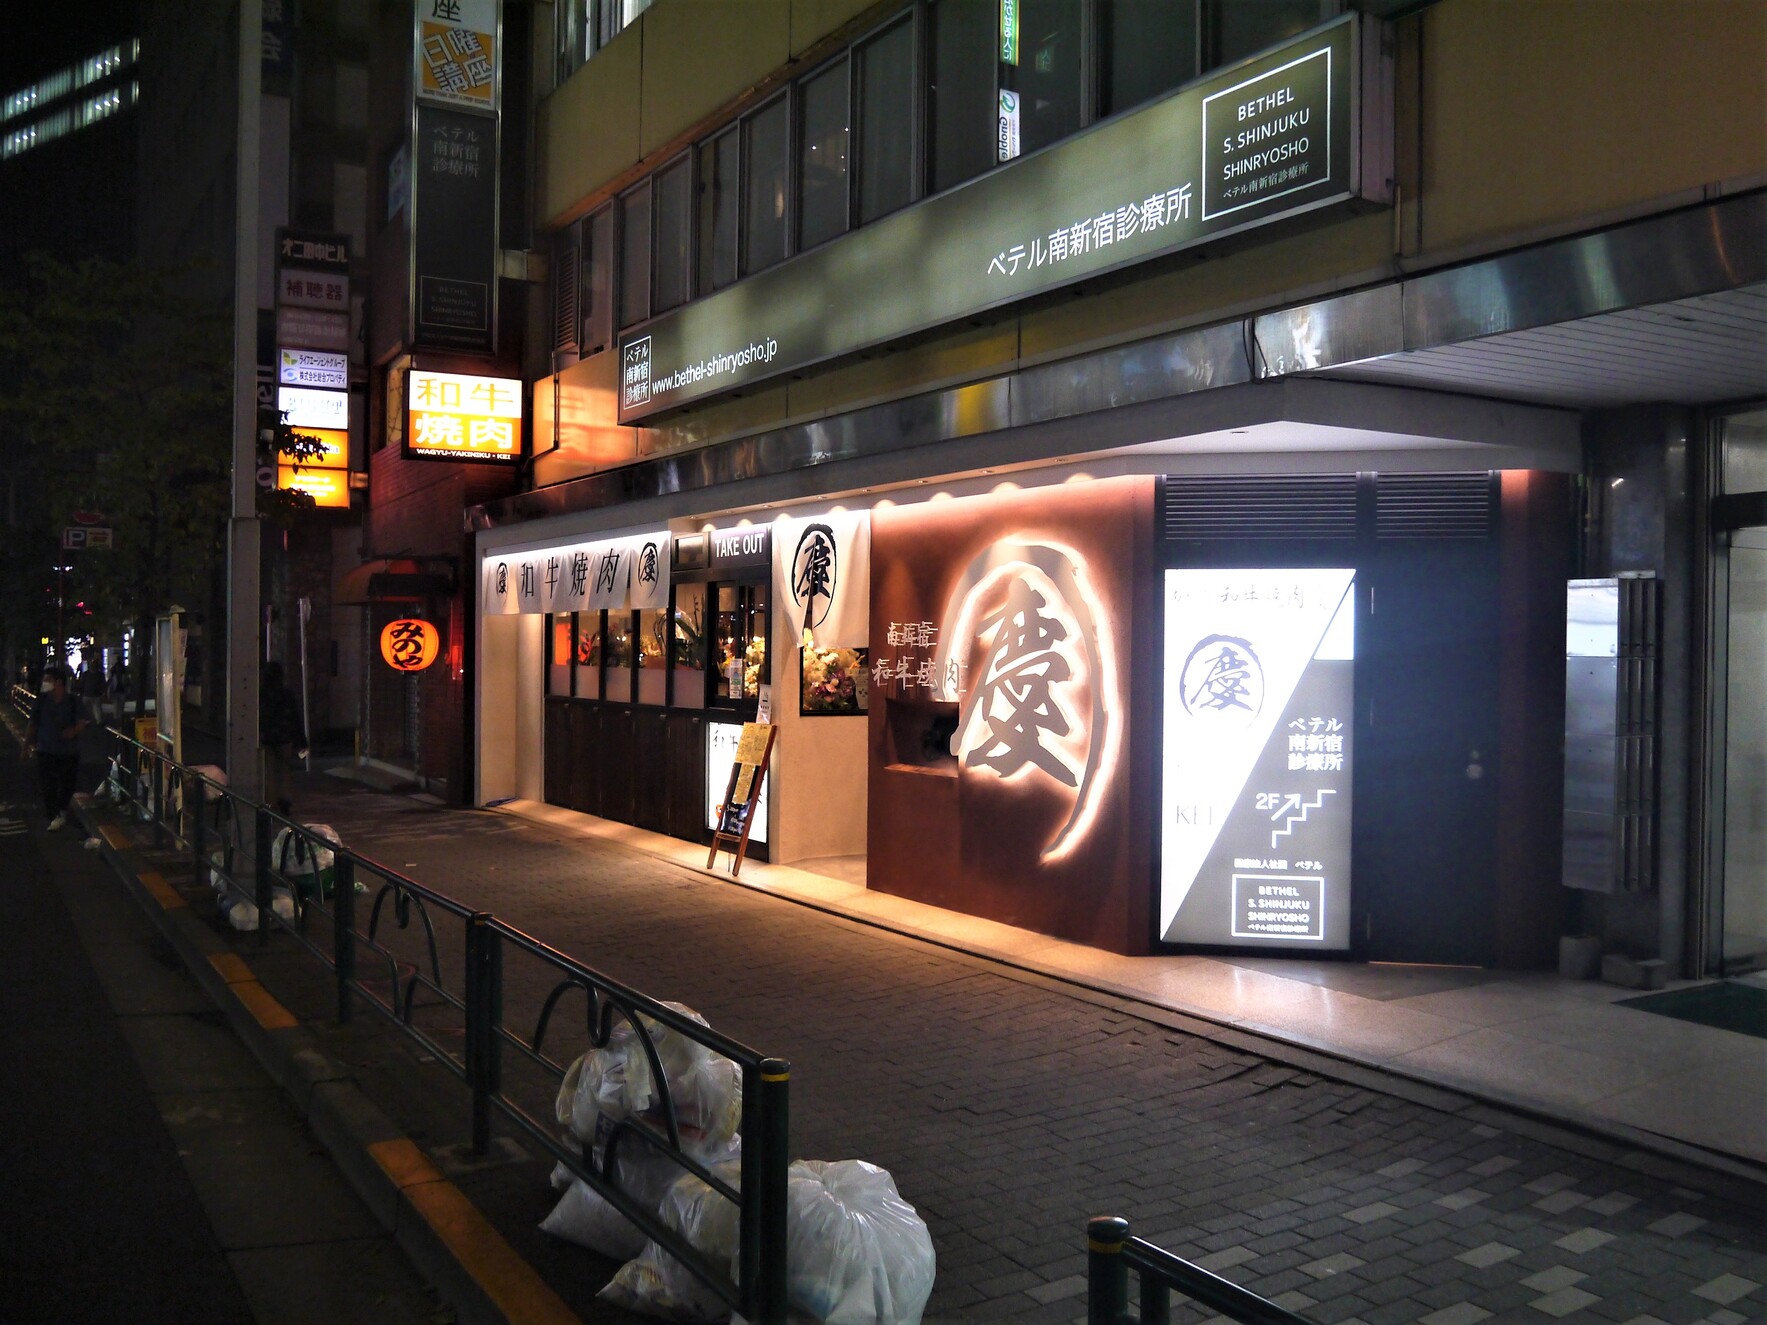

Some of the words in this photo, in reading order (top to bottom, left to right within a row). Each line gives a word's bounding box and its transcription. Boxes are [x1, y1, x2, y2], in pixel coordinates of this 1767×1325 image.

[1237, 87, 1295, 122] BETHEL
[1223, 137, 1234, 154] S.
[1237, 107, 1310, 149] SHINJUKU
[1223, 136, 1310, 181] SHINRYOSHO
[1223, 161, 1310, 199] ベテル南新宿診療所
[987, 181, 1193, 277] ベテル南新宿診療所
[286, 279, 344, 302] 補聴器
[625, 343, 649, 363] ベテル
[651, 336, 778, 395] www.bethel-shinryosho.jp
[625, 360, 649, 386] 南新宿
[416, 378, 514, 412] 和牛
[625, 380, 649, 405] 診療所
[414, 413, 514, 450] 焼肉
[714, 536, 740, 558] TAKE
[742, 532, 765, 555] OUT
[520, 547, 621, 600] 和牛焼肉
[390, 621, 425, 669] みのや
[1287, 716, 1344, 733] ベテル
[1287, 733, 1344, 753] 南新宿
[1287, 752, 1344, 771] 診療所
[1254, 792, 1282, 810] 2F
[1294, 860, 1323, 871] ベテル
[1258, 885, 1300, 897] BETHEL
[1258, 898, 1310, 910] SHINJUKU
[1247, 911, 1310, 923] SHINRYOSHO
